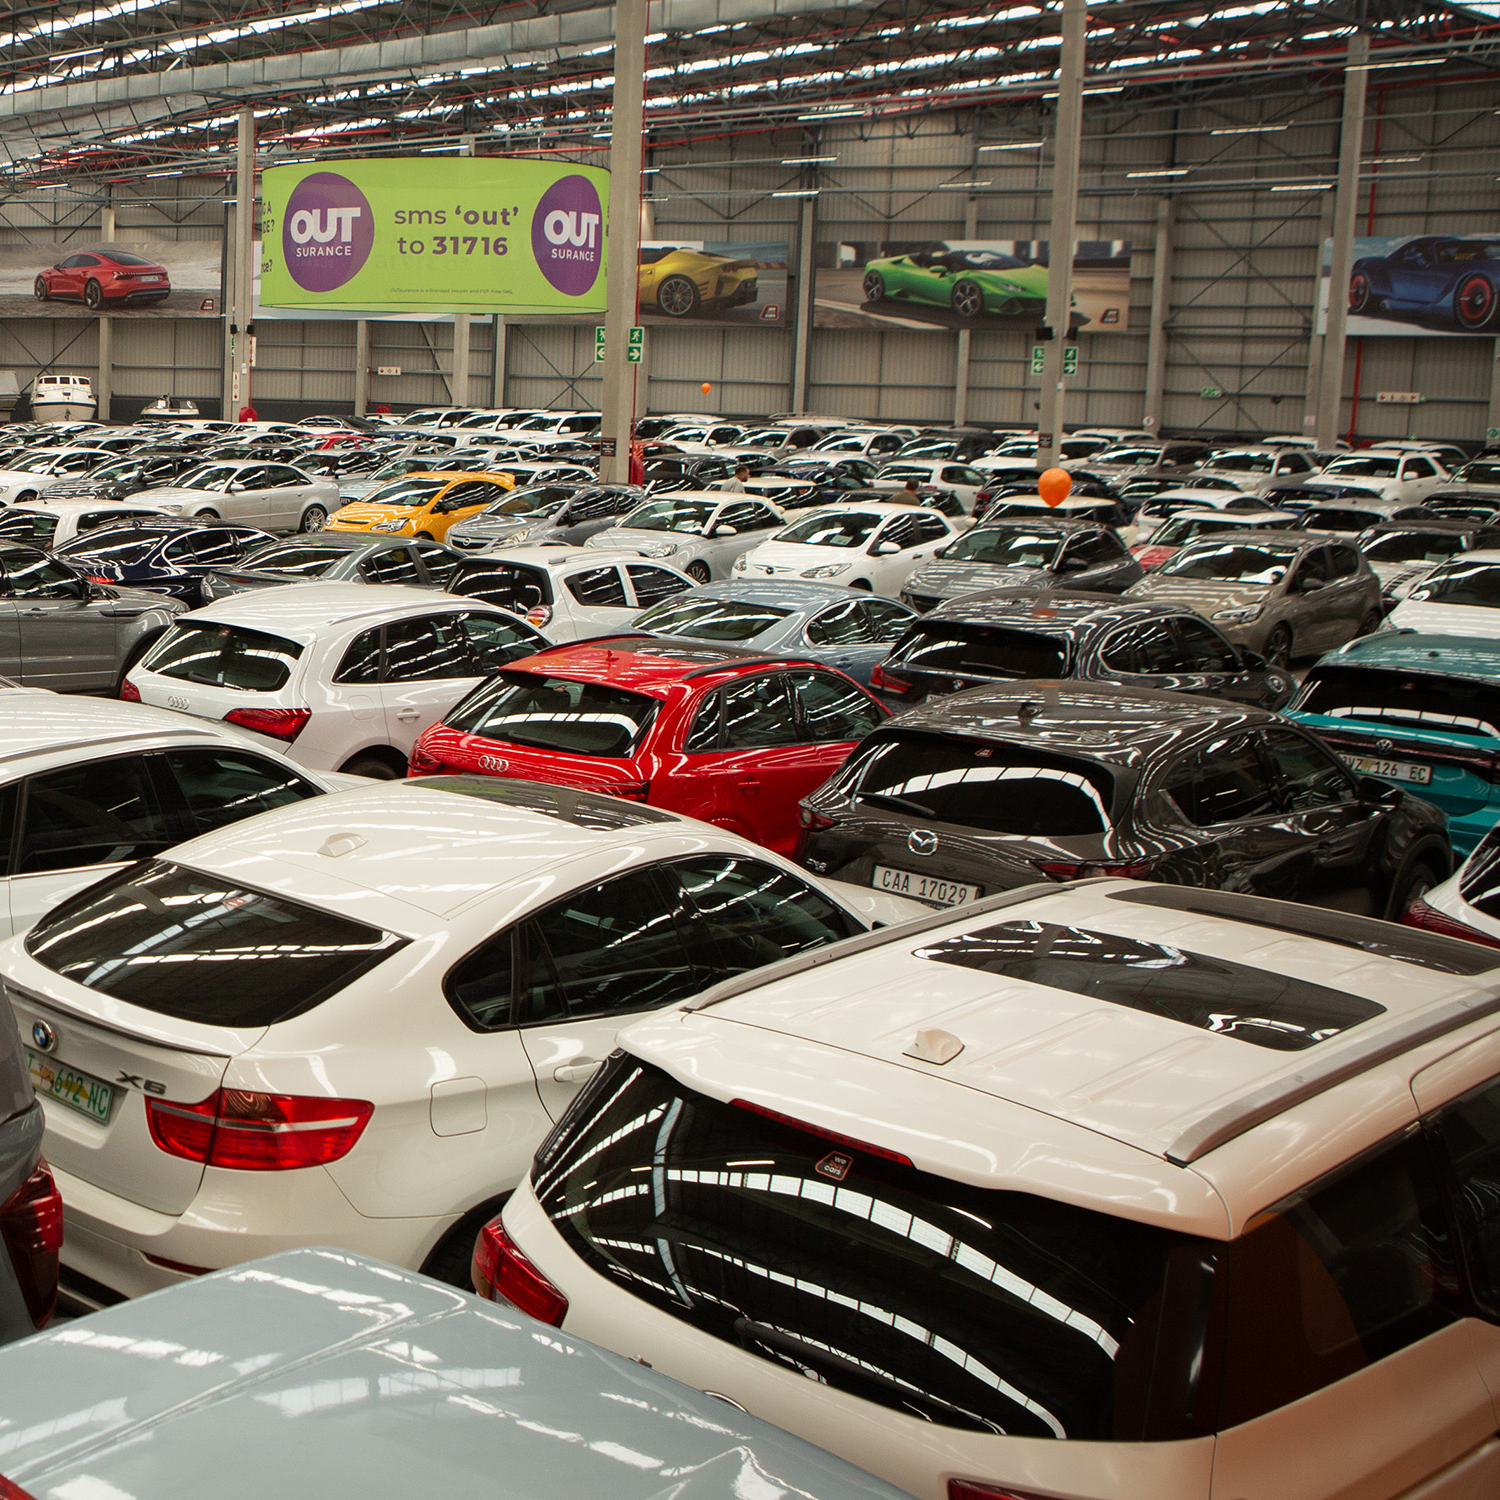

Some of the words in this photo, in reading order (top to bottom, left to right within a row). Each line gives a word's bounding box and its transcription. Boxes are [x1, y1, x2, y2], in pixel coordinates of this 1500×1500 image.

[290, 206, 361, 244] OUT
[394, 209, 447, 225] sms
[543, 209, 600, 249] OUT
[295, 245, 352, 257] SURANCE
[397, 237, 425, 255] to
[432, 236, 508, 256] 31716
[551, 248, 595, 262] SURANCE
[1373, 761, 1398, 776] 126
[1409, 766, 1427, 781] EC
[882, 870, 910, 892] CAA
[918, 878, 967, 905] 17029
[54, 1069, 83, 1104] 692
[87, 1084, 109, 1115] NC
[115, 1069, 167, 1095] X6
